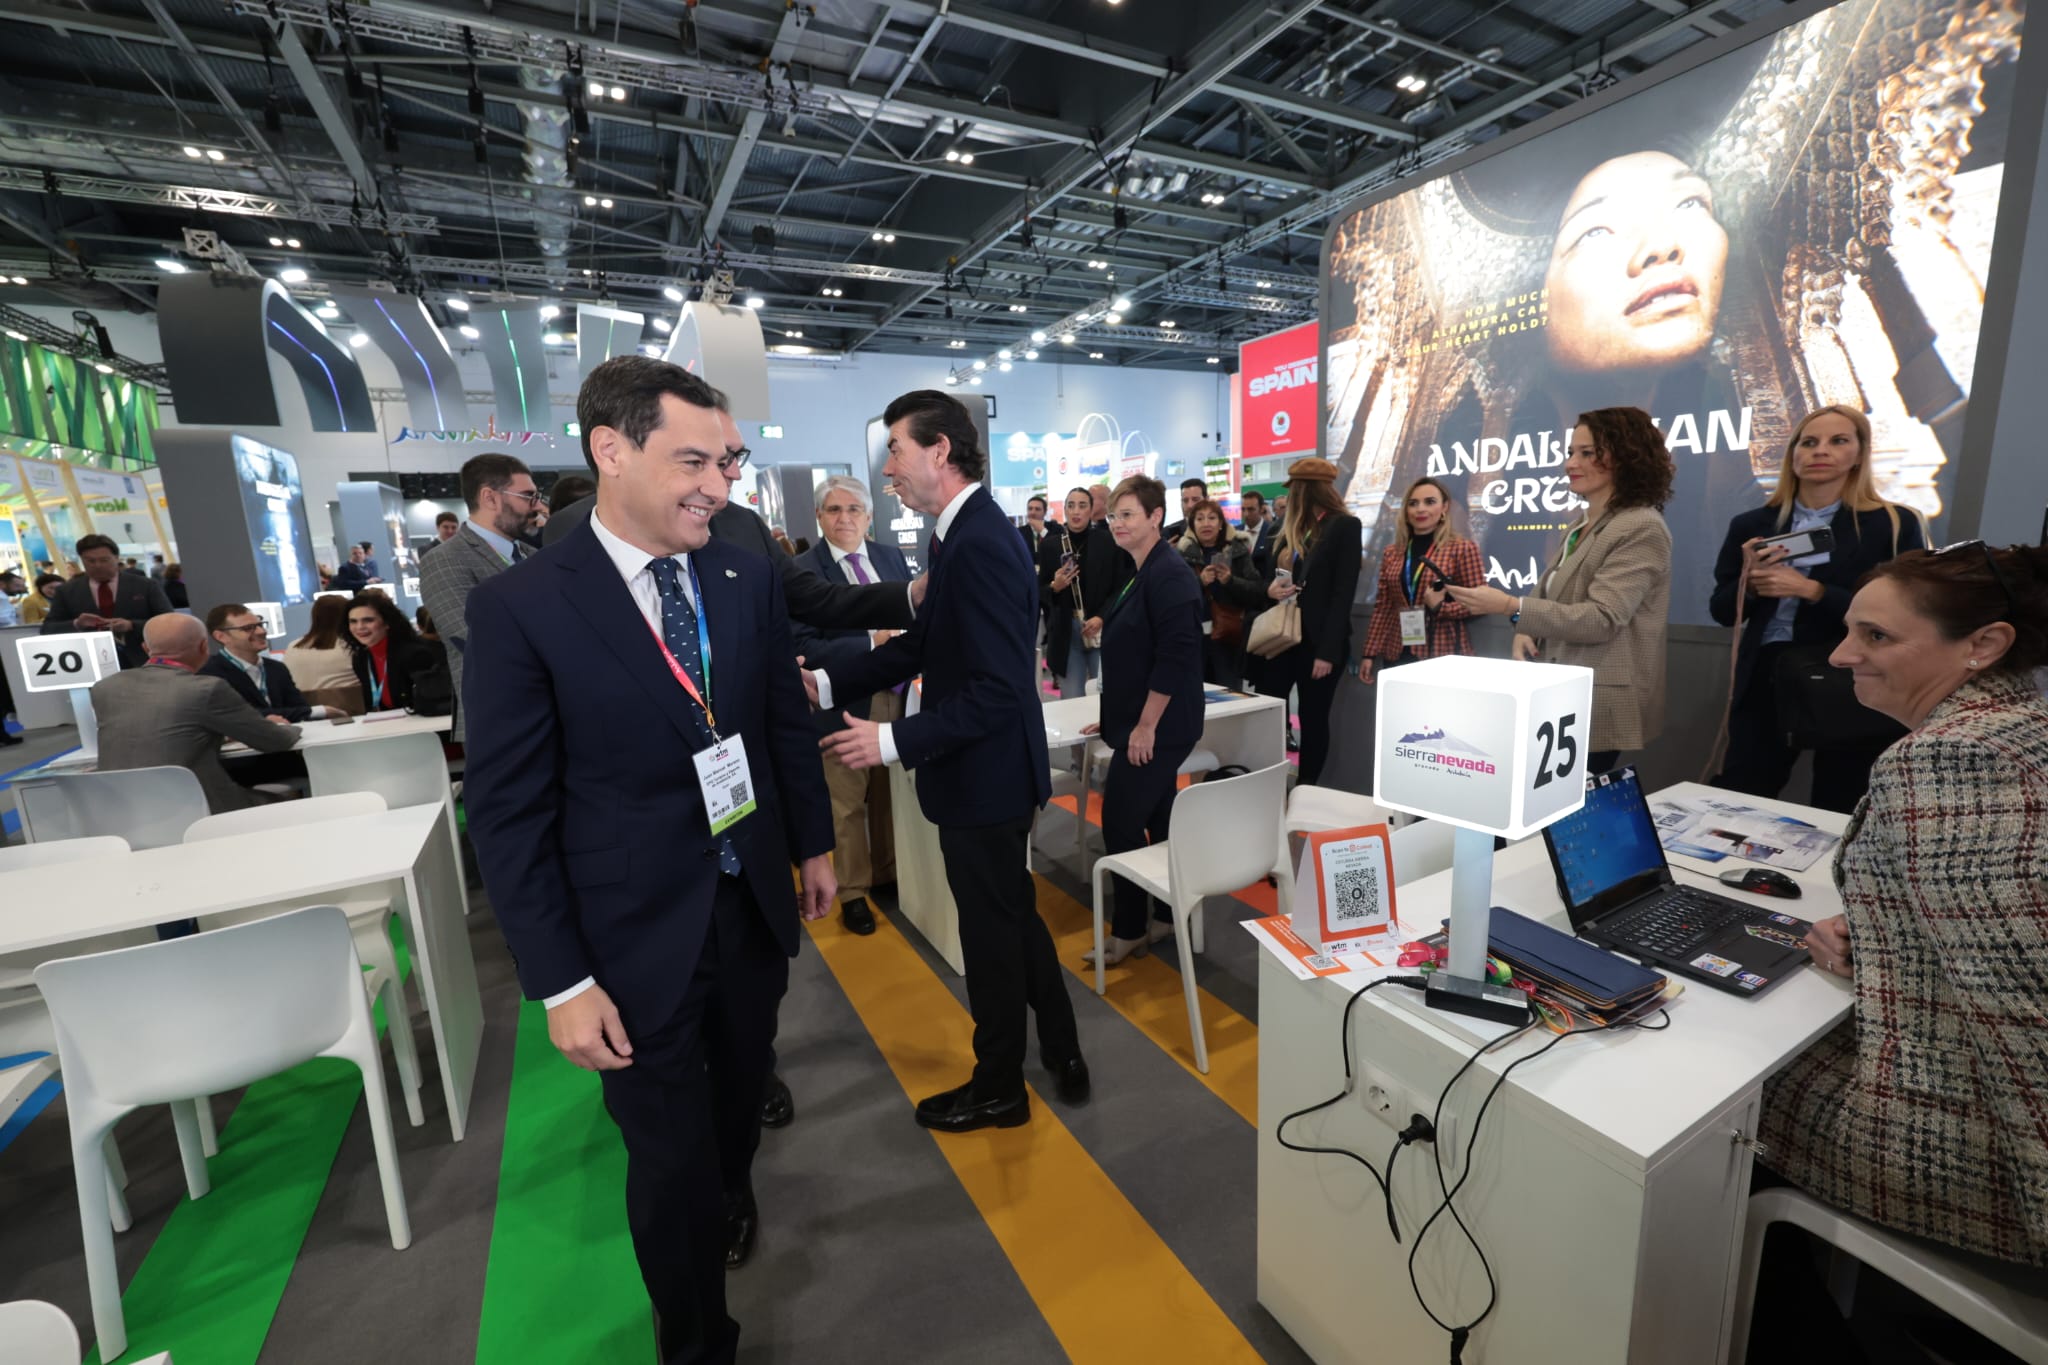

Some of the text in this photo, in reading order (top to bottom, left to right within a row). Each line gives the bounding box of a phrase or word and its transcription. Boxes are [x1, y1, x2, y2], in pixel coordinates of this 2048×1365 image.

[1465, 288, 1550, 318] HOW MUCH
[1432, 302, 1549, 339] ALHAMBRA CAN
[1446, 329, 1491, 349] HEART
[1498, 316, 1548, 336] HOLD?
[1249, 363, 1318, 397] SPAIN
[1007, 447, 1047, 462] SPA
[33, 651, 83, 676] 20
[1395, 745, 1496, 775] sierranevada
[1533, 713, 1577, 790] 25
[1331, 942, 1347, 950] wtm
